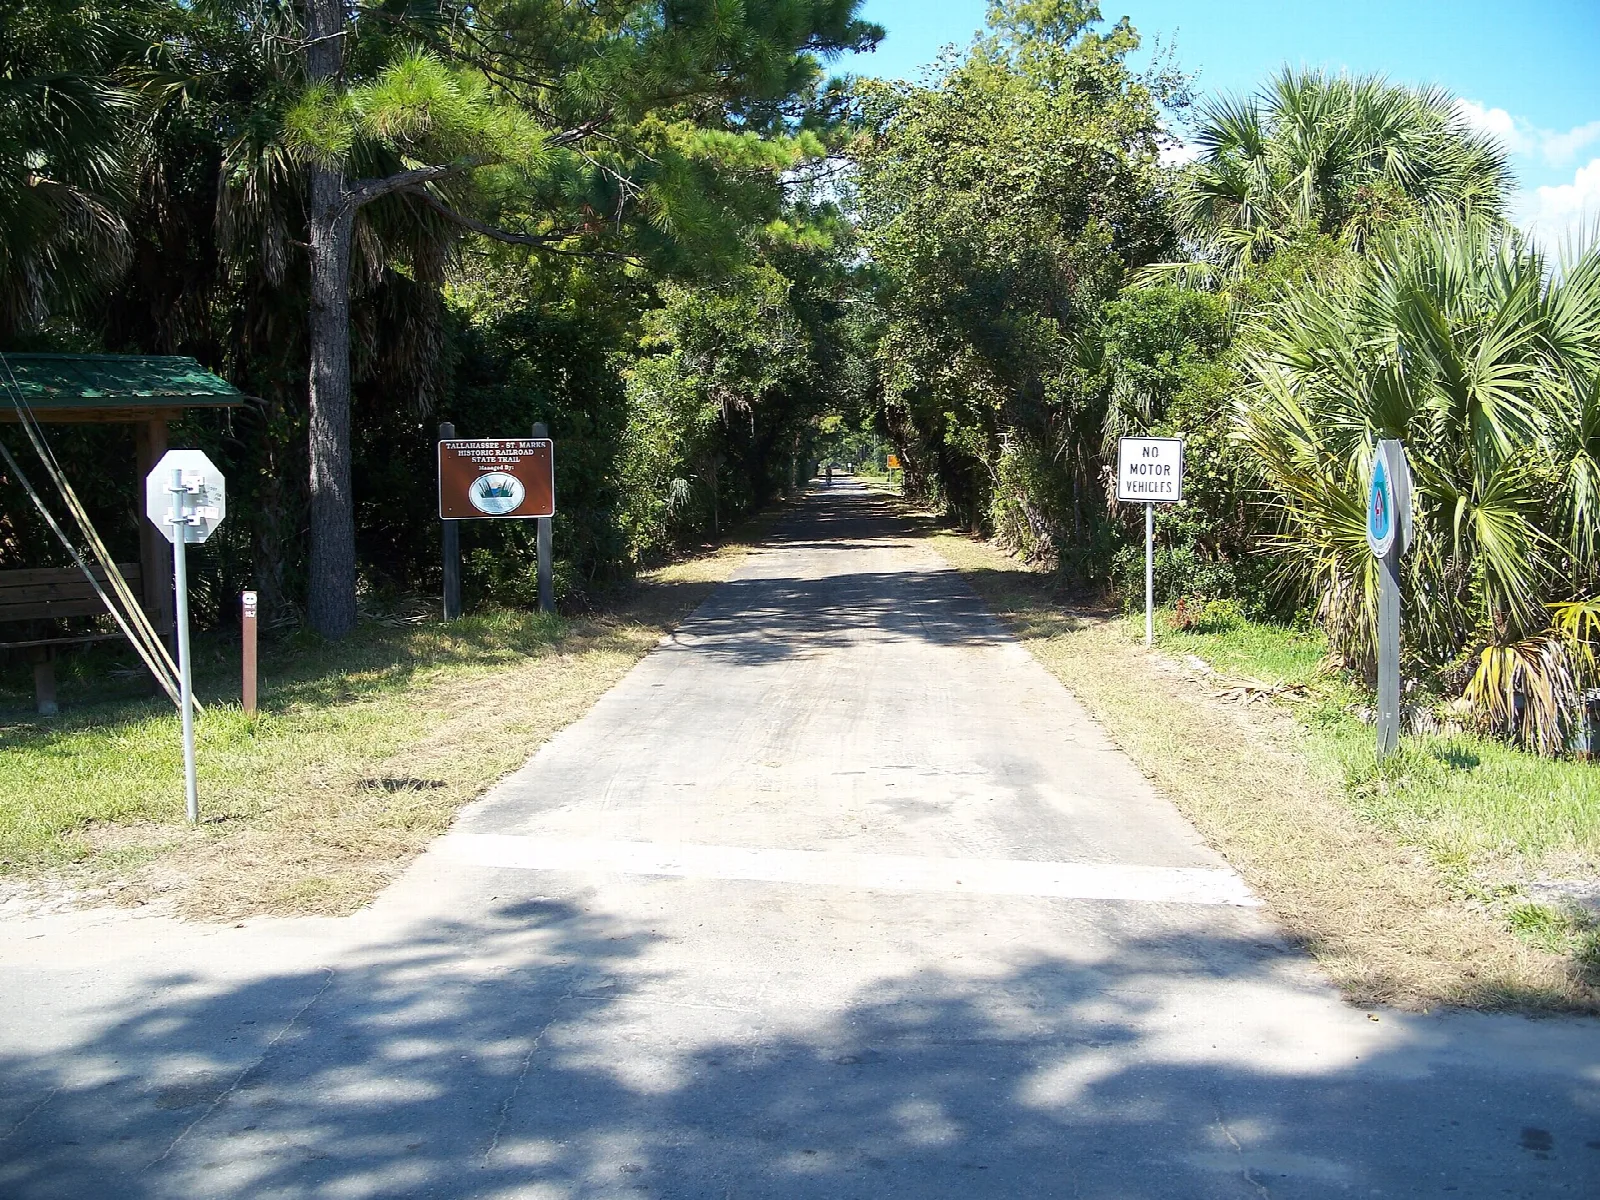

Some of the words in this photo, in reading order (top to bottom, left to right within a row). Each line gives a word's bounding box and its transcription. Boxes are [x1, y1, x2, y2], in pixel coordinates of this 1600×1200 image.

[1142, 446, 1159, 458] NO
[1130, 463, 1171, 476] MOTOR
[1126, 481, 1172, 493] VEHICLES
